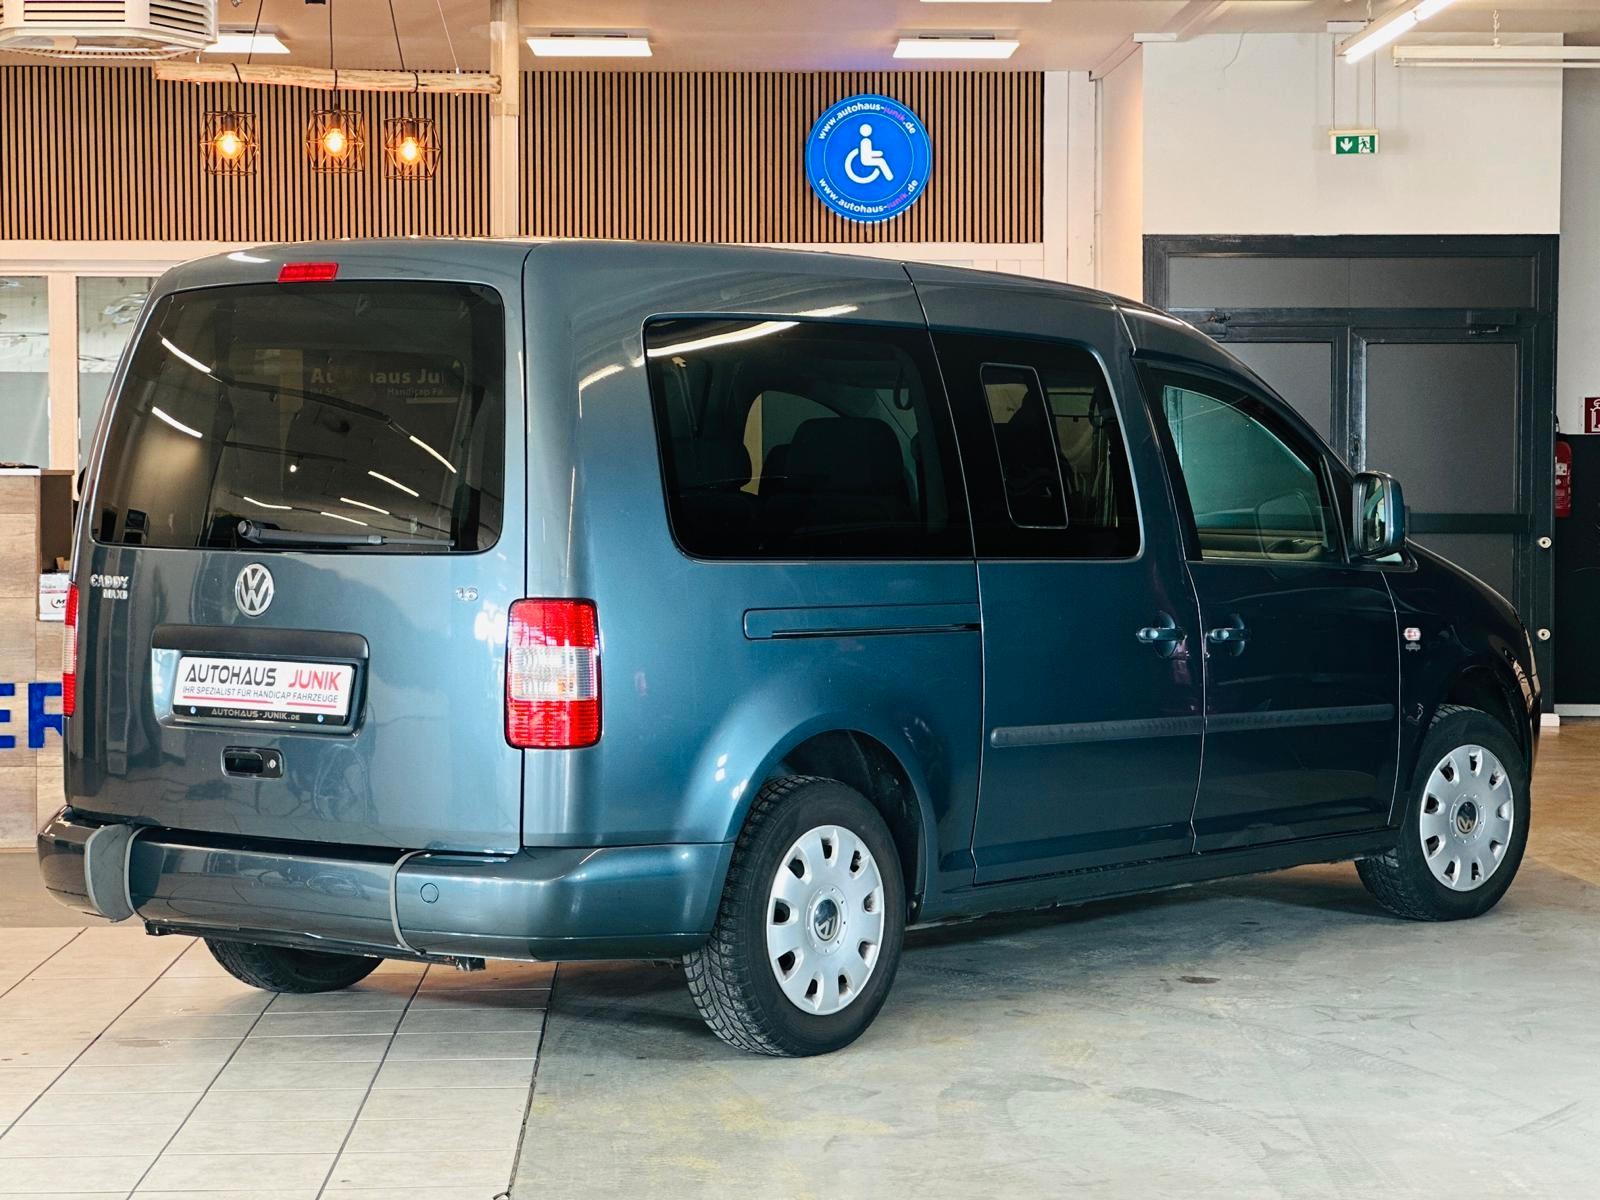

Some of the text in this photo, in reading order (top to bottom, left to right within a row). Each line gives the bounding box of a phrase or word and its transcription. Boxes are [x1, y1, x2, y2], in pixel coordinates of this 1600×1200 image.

[818, 102, 917, 140] www.autohaus-junik.de
[819, 178, 919, 213] www.autohaus-junik.de
[90, 574, 129, 589] CADDY
[185, 663, 341, 691] AUTOHAUS JUNIK
[182, 685, 195, 695] IHR
[196, 686, 236, 697] SPEZIALIST
[253, 689, 292, 701] HANDICAP
[293, 691, 340, 703] FAHRZEUGE
